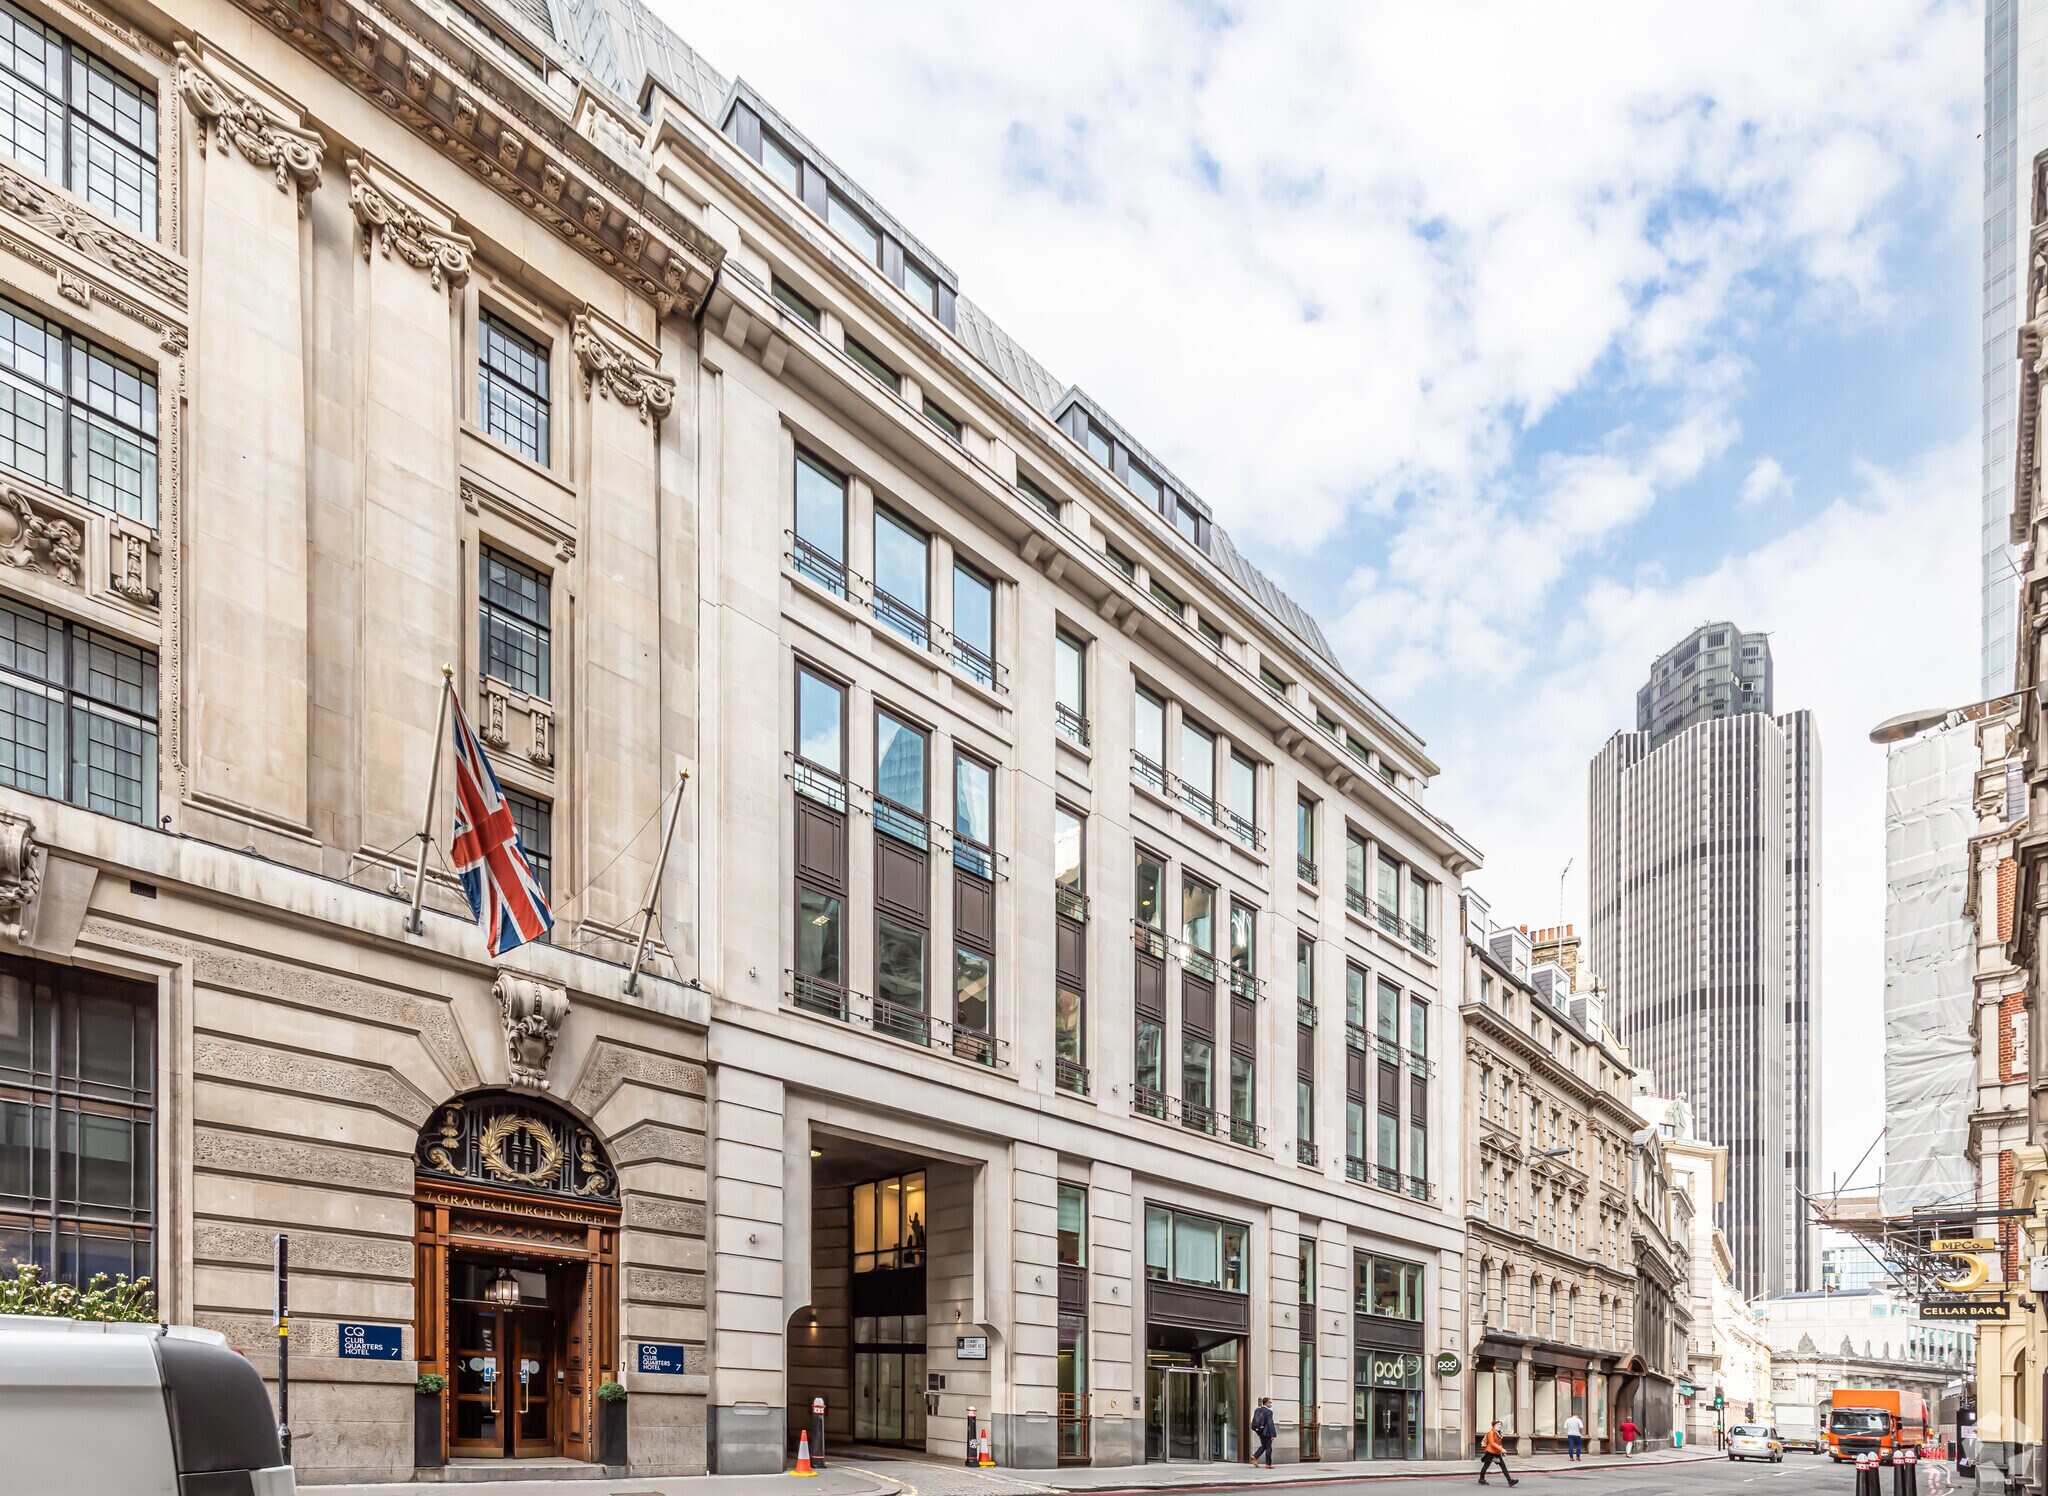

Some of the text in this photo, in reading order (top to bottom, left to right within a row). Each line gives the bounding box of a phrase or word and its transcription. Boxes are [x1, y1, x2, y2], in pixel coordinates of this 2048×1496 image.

[424, 1191, 610, 1225] 7 GRACECHURCH STREET
[1942, 1241, 1983, 1249] MPCo.
[1923, 1307, 1994, 1315] CELLAR BAR
[344, 1326, 365, 1336] CQ
[391, 1347, 399, 1356] 7
[643, 1345, 657, 1354] CQ
[675, 1363, 681, 1371] 7
[1437, 1359, 1457, 1370] pod
[1374, 1358, 1403, 1382] pod
[1110, 1396, 1117, 1409] 6
